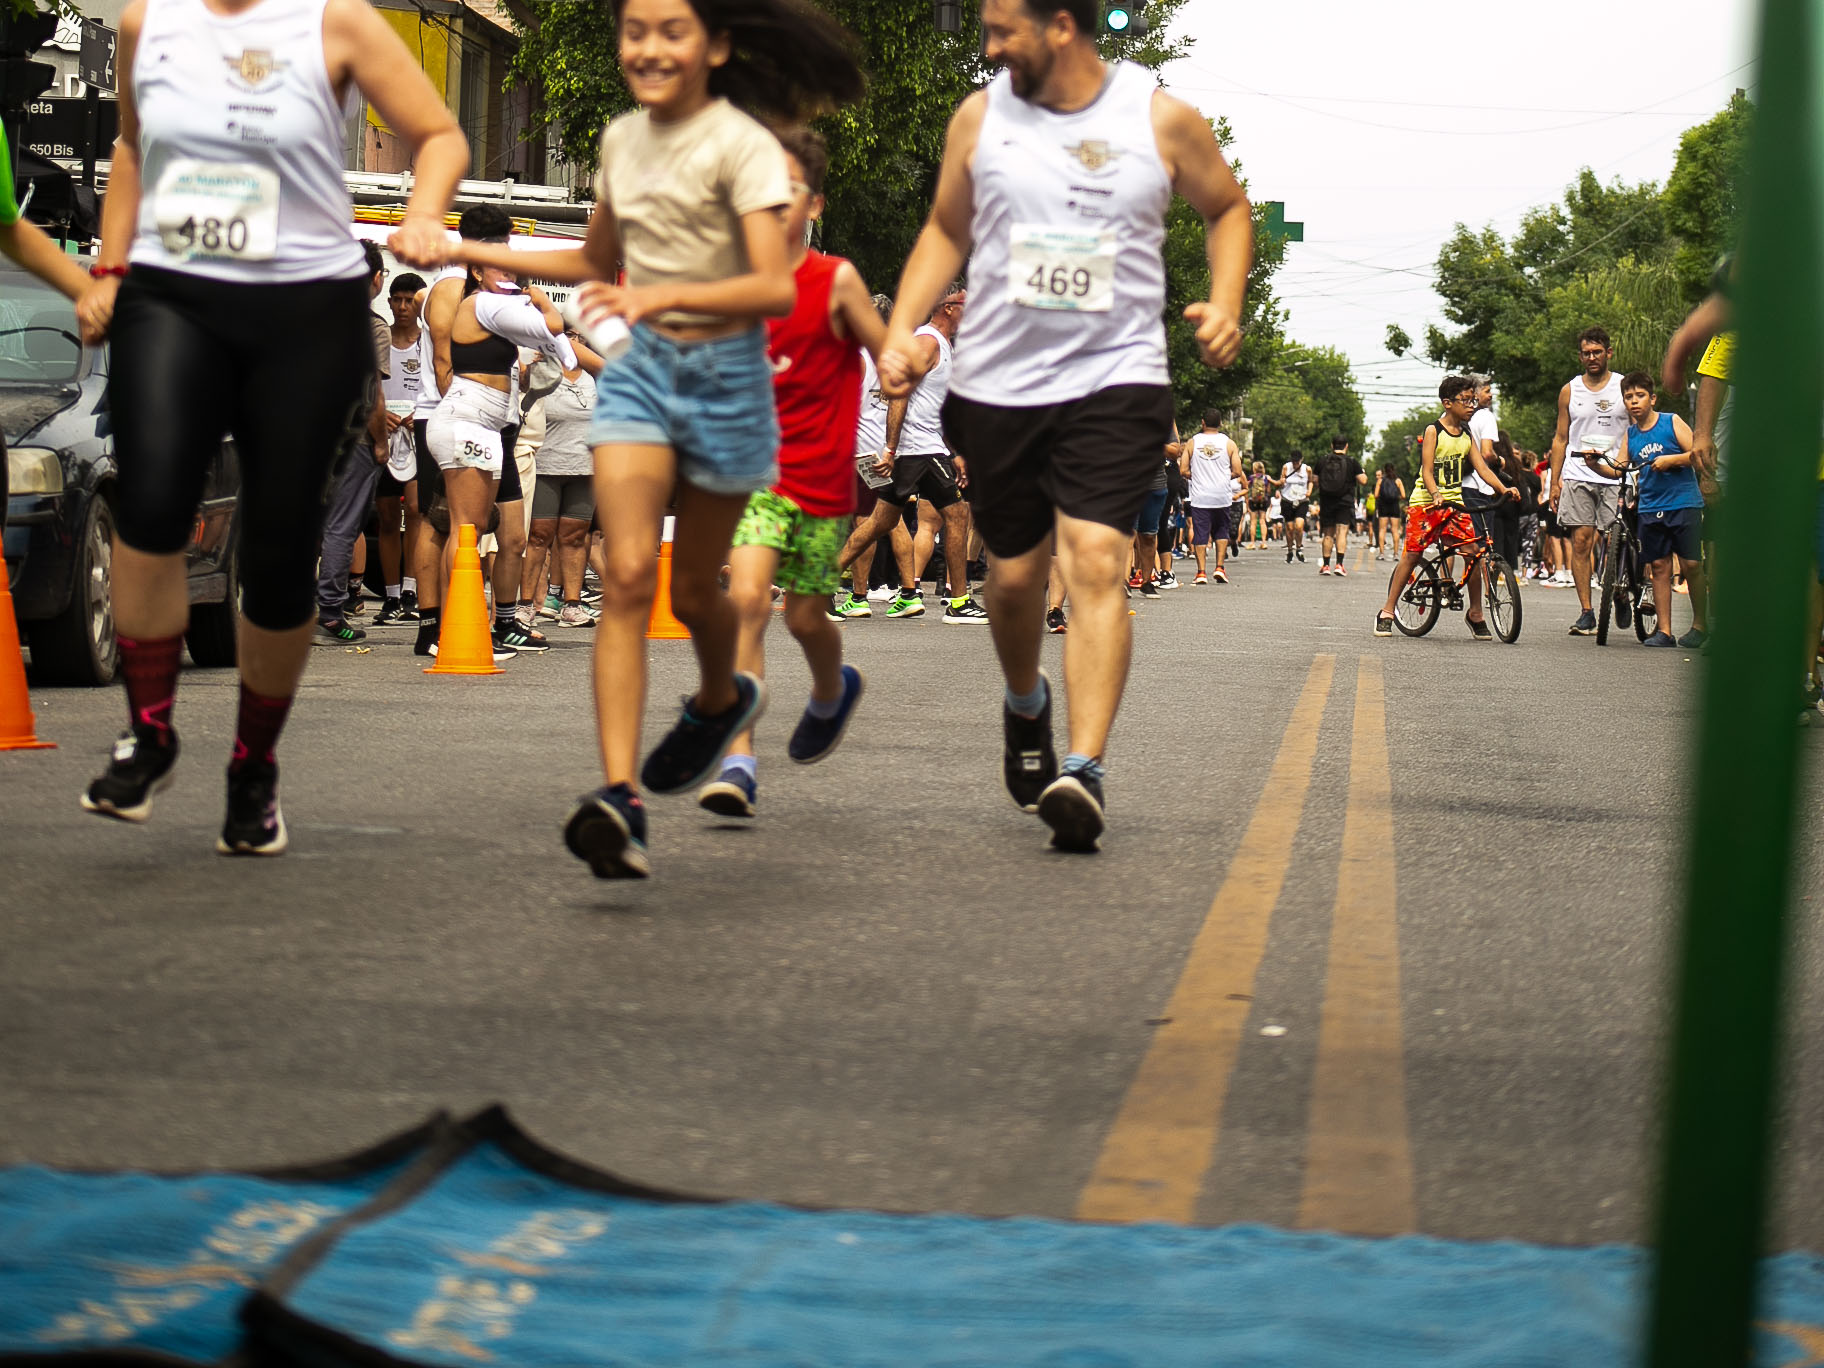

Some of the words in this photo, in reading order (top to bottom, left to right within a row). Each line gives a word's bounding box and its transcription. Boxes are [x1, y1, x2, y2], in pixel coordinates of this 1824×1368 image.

[29, 143, 52, 156] 650
[53, 144, 74, 156] Bis
[178, 216, 248, 252] 480
[1027, 264, 1091, 297] 469
[463, 440, 493, 460] 596
